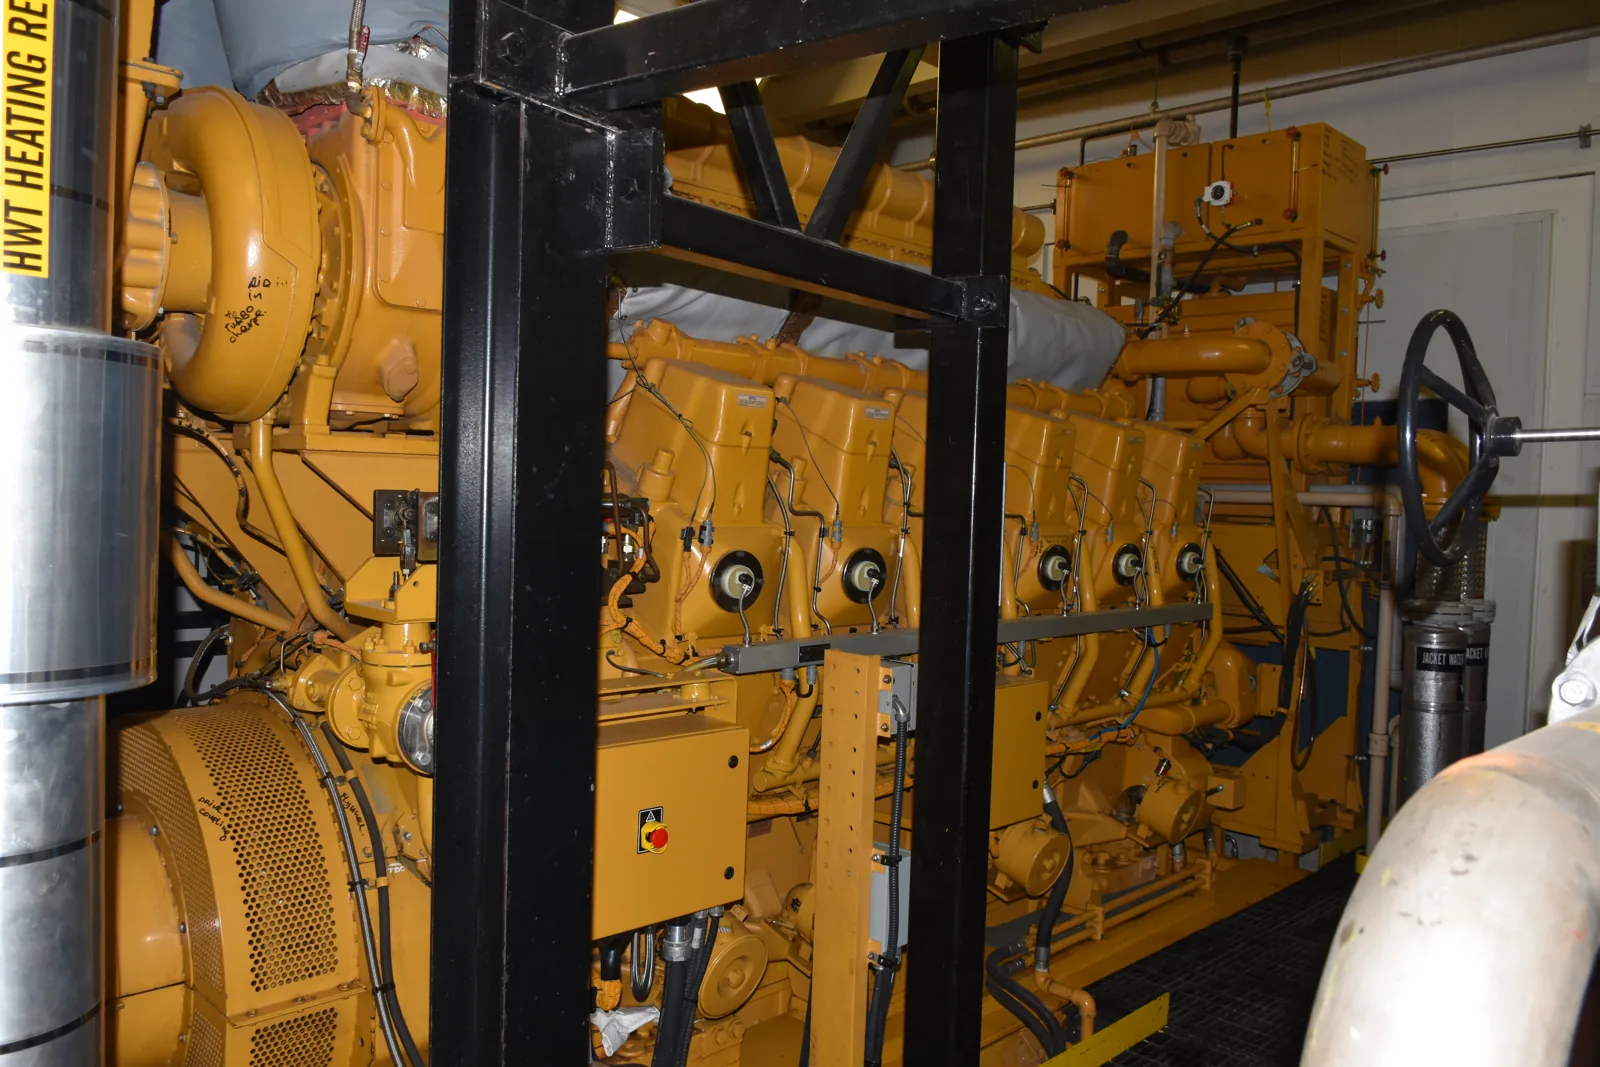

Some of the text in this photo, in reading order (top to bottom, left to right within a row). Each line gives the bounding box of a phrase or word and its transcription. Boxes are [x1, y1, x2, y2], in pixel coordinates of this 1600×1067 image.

[3, 0, 48, 273] HWT HEATING RE
[1422, 651, 1446, 665] JACKET
[1466, 647, 1483, 659] ACKET
